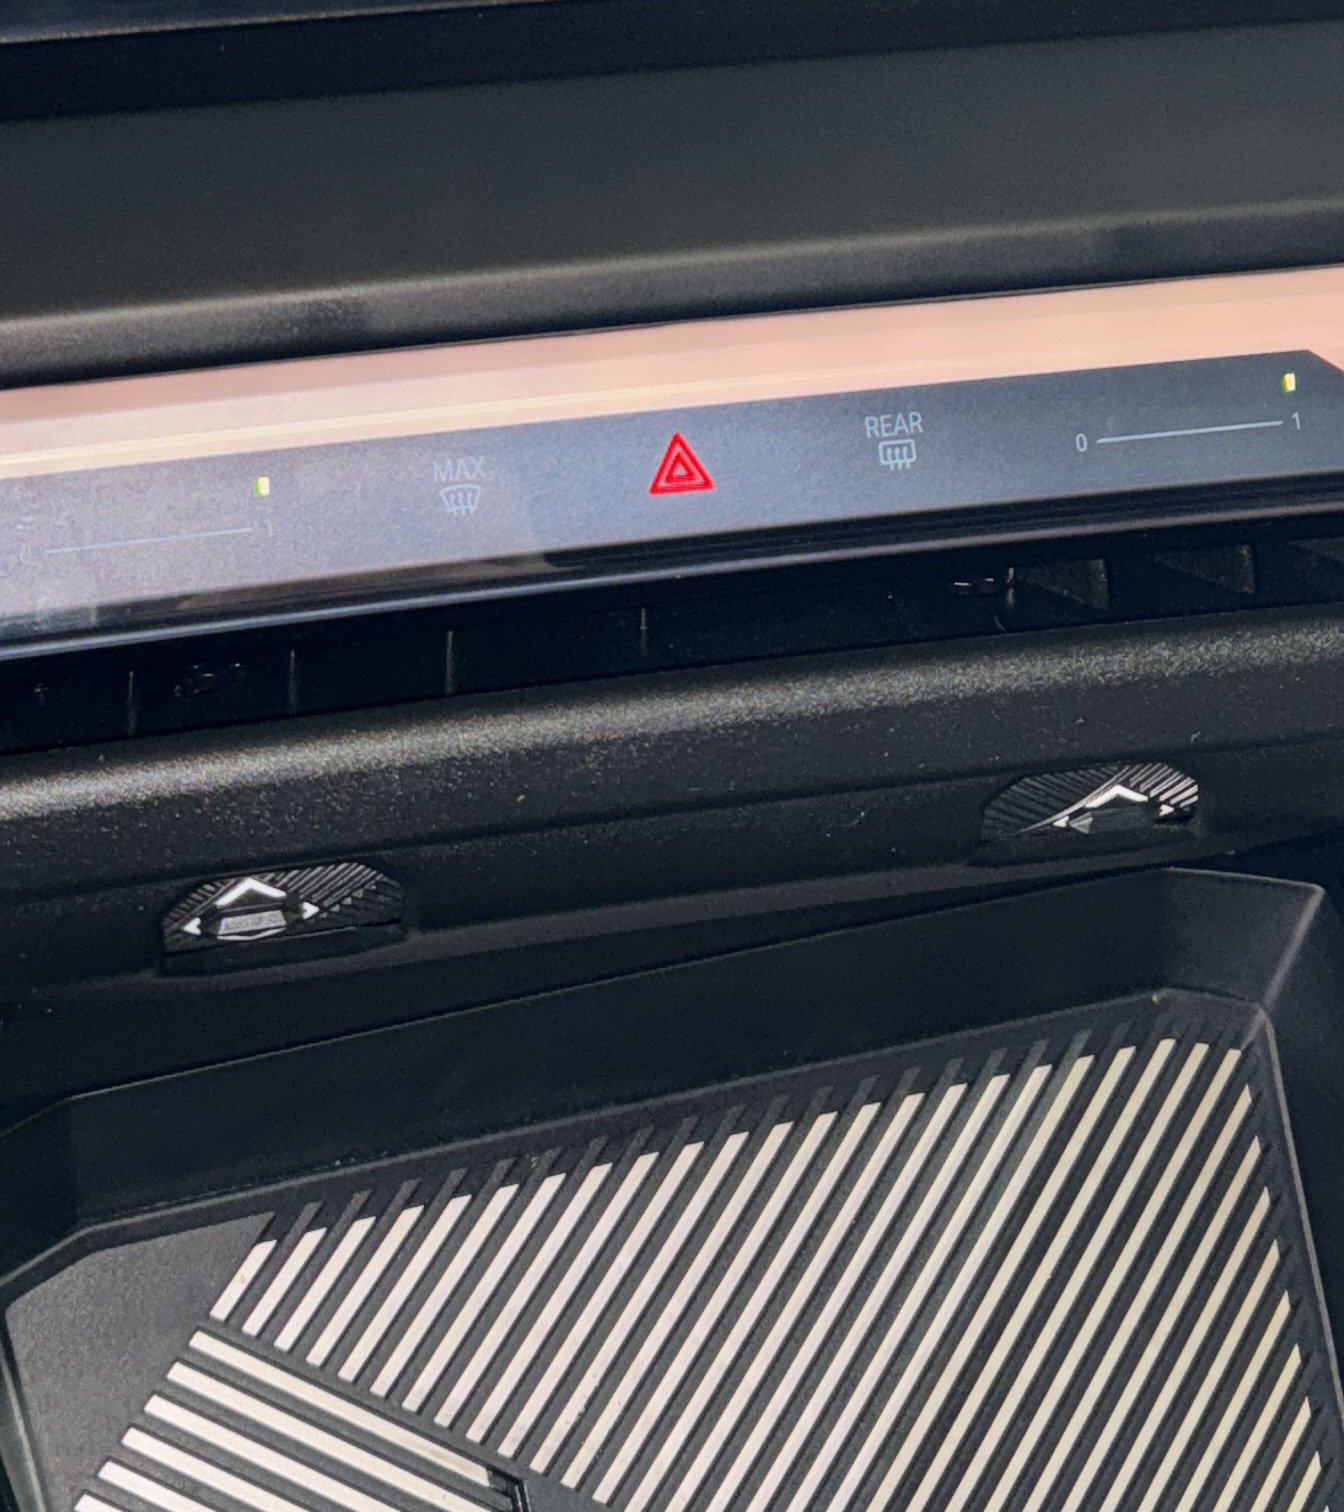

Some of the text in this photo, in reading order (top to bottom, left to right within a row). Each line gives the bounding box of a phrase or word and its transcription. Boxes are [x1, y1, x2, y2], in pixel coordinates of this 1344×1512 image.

[865, 410, 923, 438] REAR
[1074, 412, 1301, 453] 0 1
[432, 455, 486, 483] MAX
